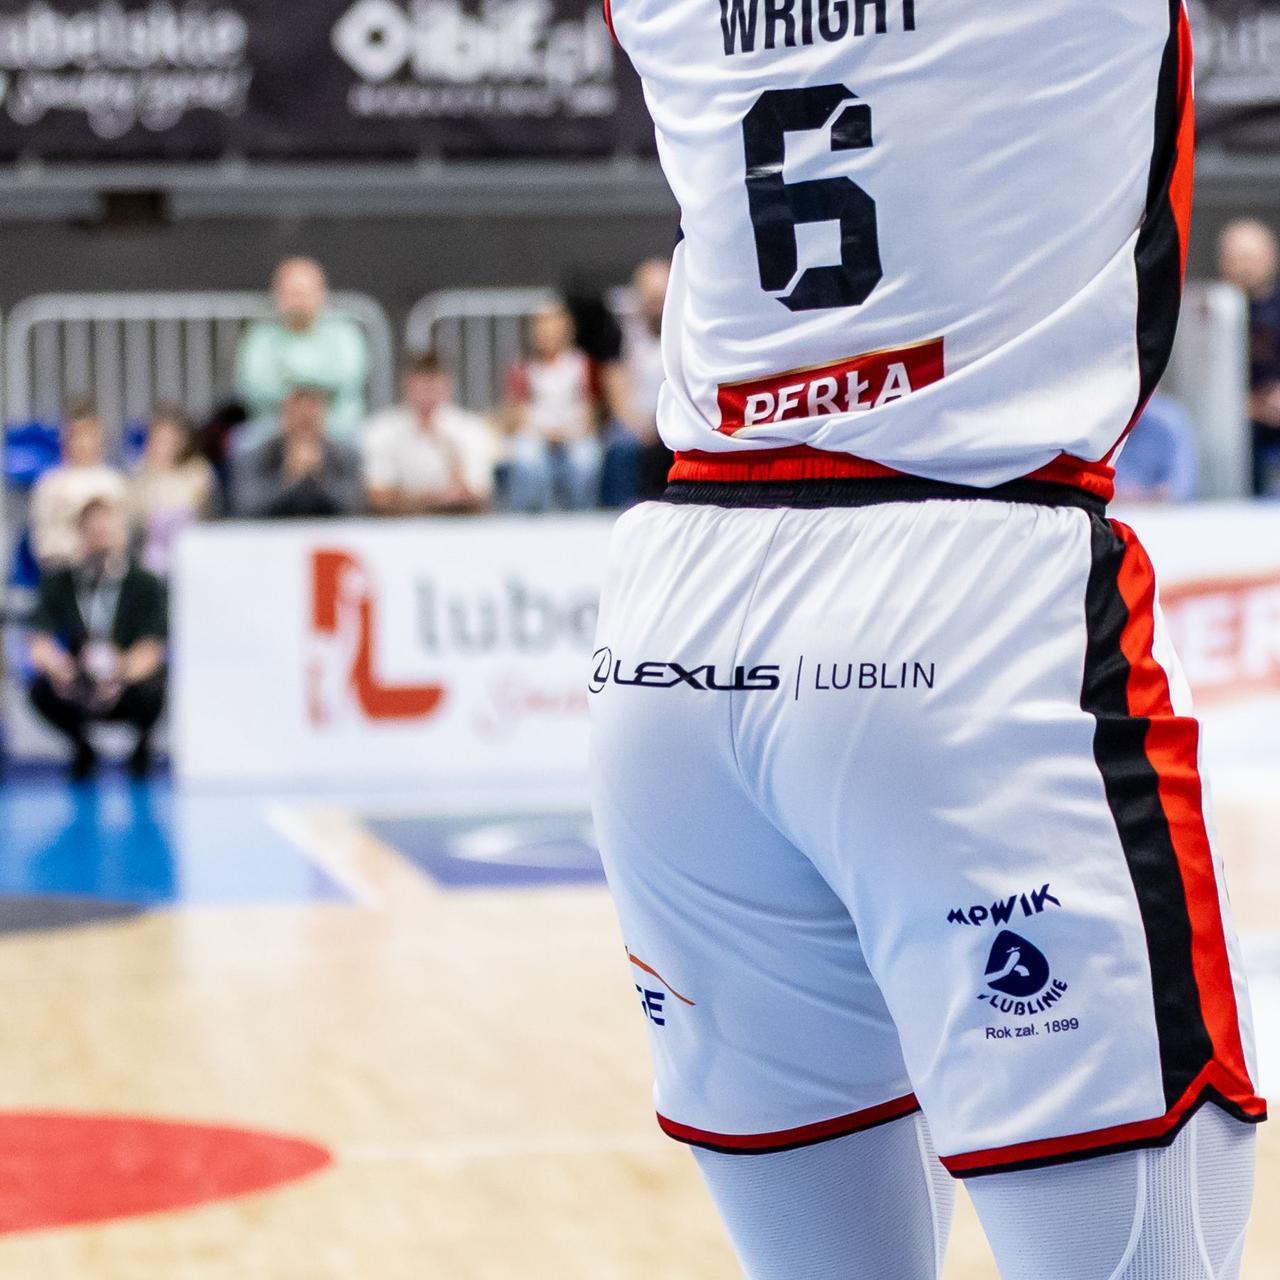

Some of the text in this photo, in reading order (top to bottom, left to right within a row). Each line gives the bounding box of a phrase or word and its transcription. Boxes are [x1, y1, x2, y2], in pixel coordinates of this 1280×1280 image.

[742, 83, 884, 312] 6
[743, 361, 915, 428] PERŁA
[613, 659, 936, 692] LEXUS LUBLIN
[988, 977, 1069, 1017] LUBLINIE
[985, 1017, 1080, 1040] Rok zał. 1899
